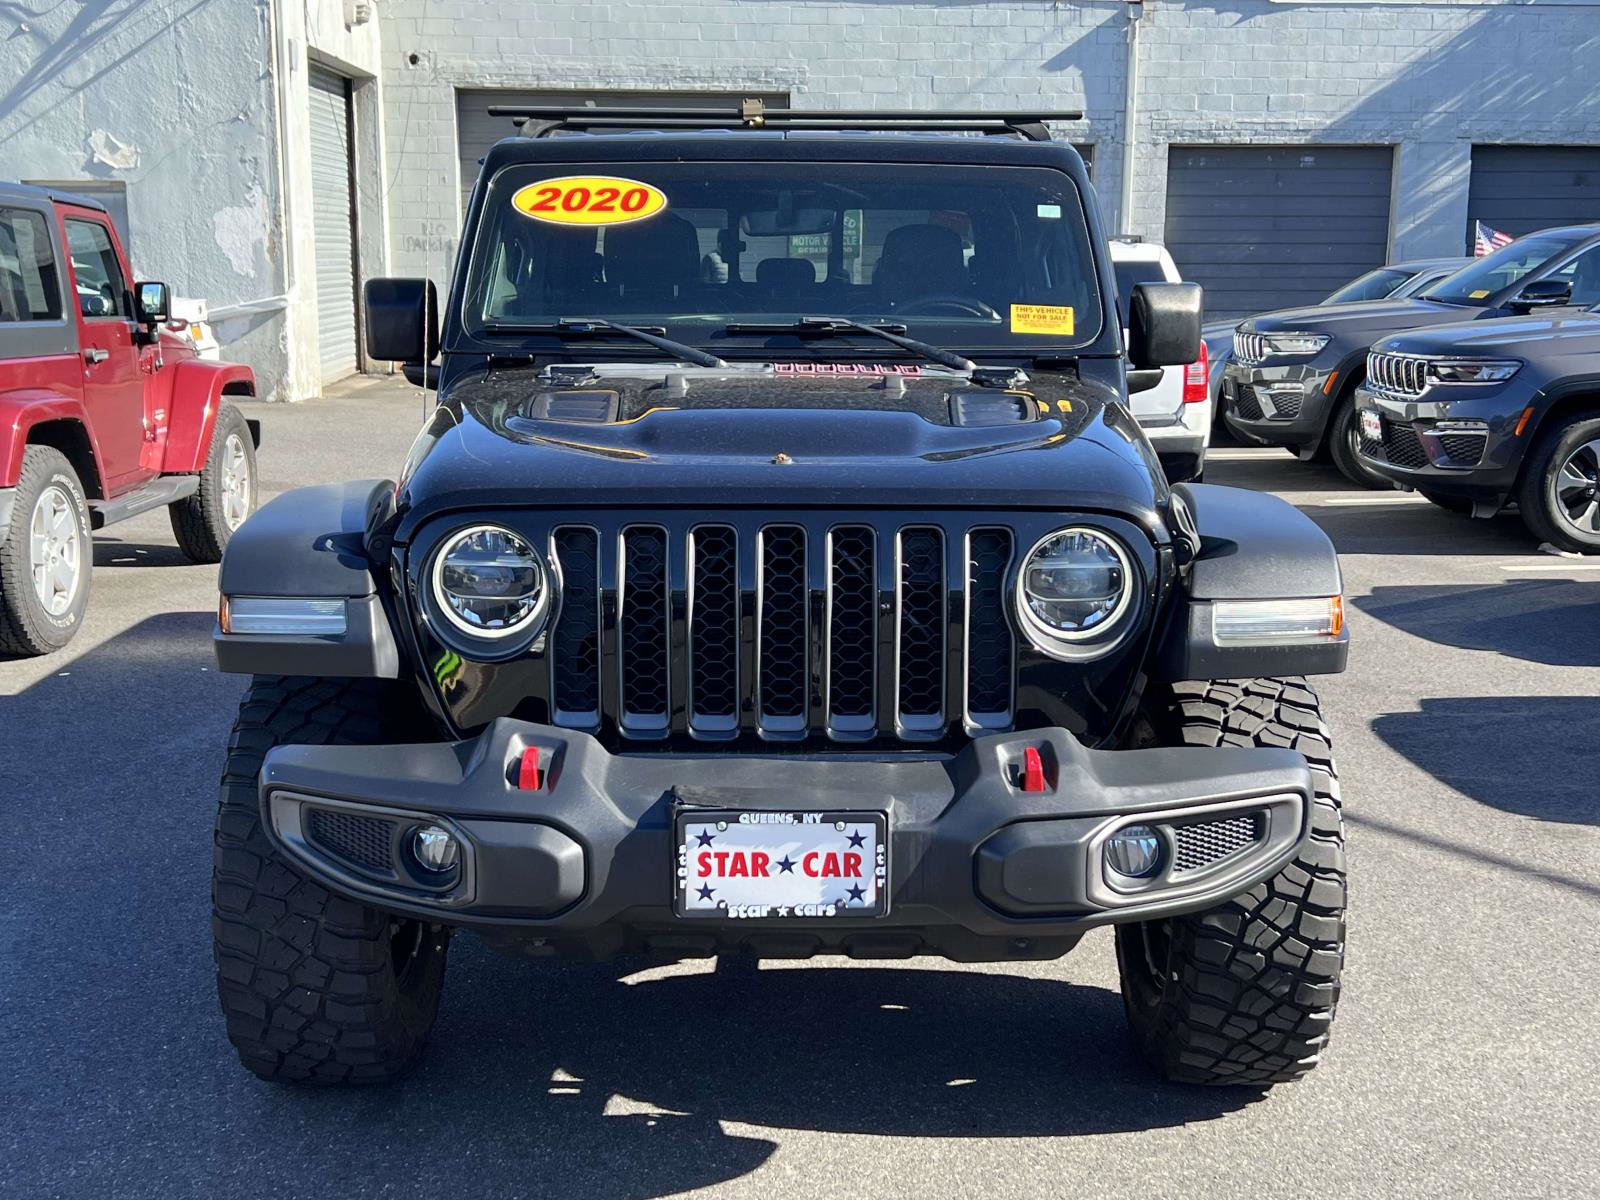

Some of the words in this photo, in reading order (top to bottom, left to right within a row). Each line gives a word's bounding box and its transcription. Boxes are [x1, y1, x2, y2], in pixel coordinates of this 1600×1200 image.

[529, 187, 649, 212] 2020
[792, 236, 820, 246] MOTOR
[739, 813, 798, 826] QUEENS,
[803, 813, 823, 824] NY
[697, 852, 770, 877] STAR
[802, 851, 862, 878] CAR
[727, 903, 771, 918] star
[794, 904, 836, 916] cars
